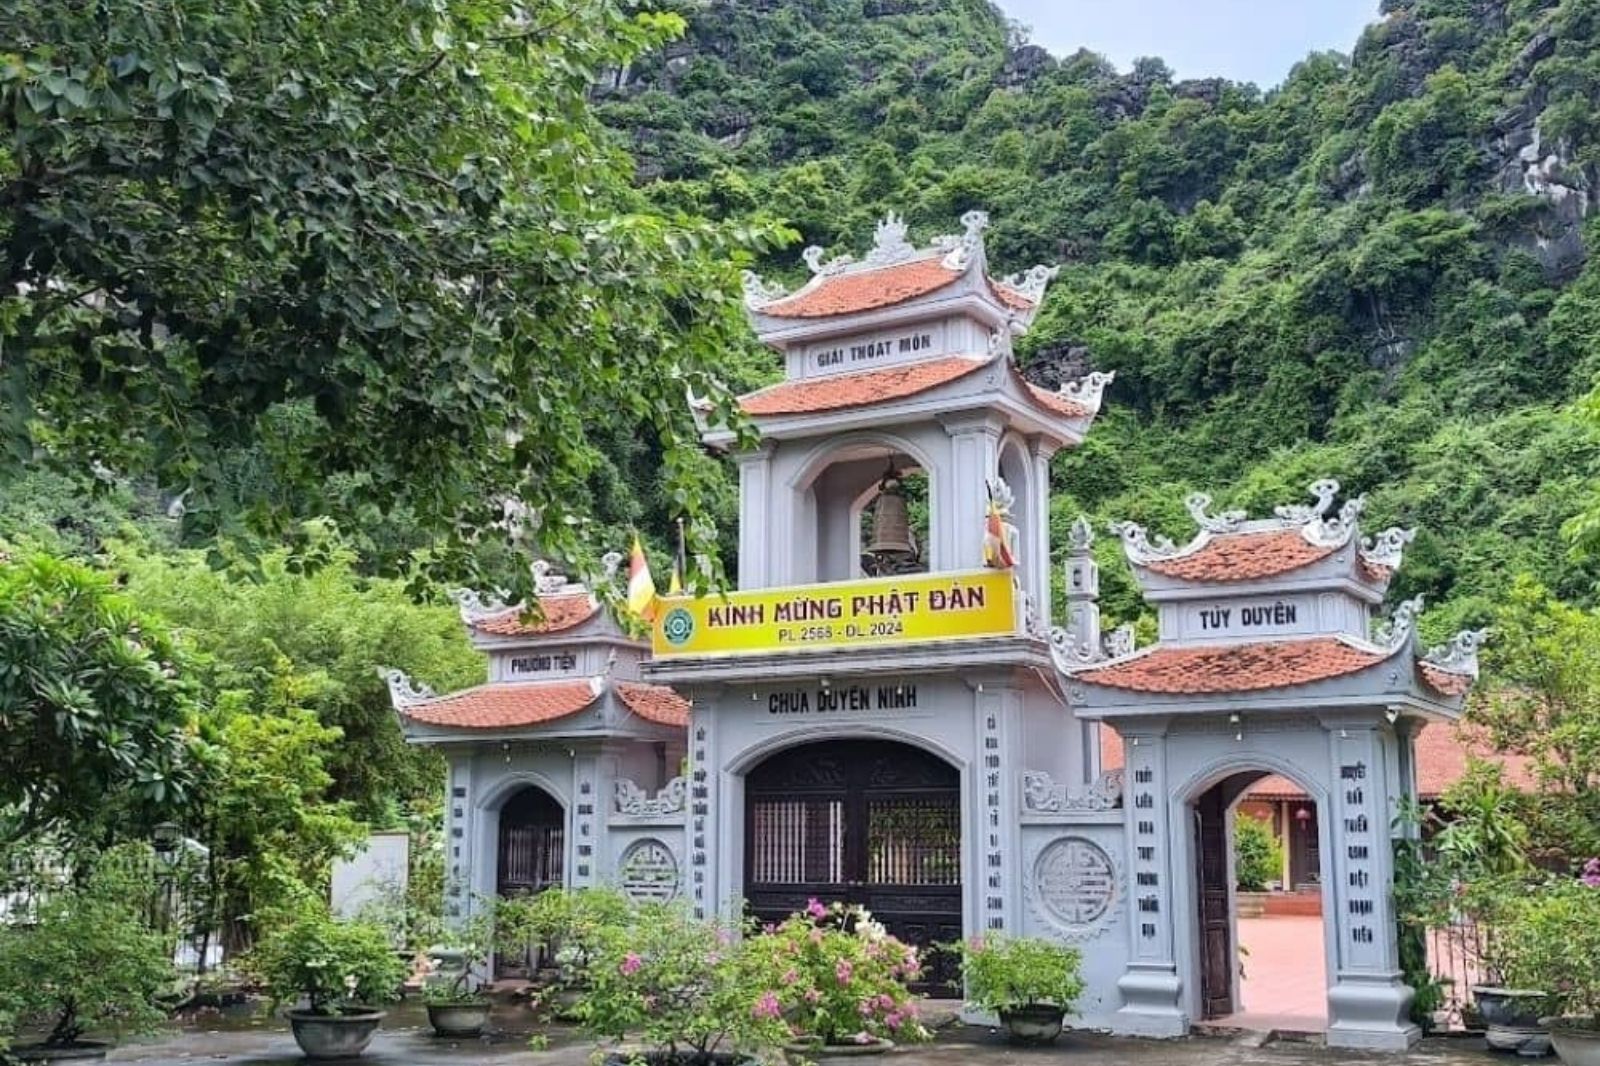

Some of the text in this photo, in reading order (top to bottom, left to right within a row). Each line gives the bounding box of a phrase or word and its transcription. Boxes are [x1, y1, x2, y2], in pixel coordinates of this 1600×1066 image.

[899, 333, 931, 353] MÔN
[708, 582, 984, 627] KÍNH MỪNG PHẬT ĐẢN
[1242, 602, 1296, 626] DUYÊN
[769, 684, 916, 714] CHÙA DUYÊN NINH
